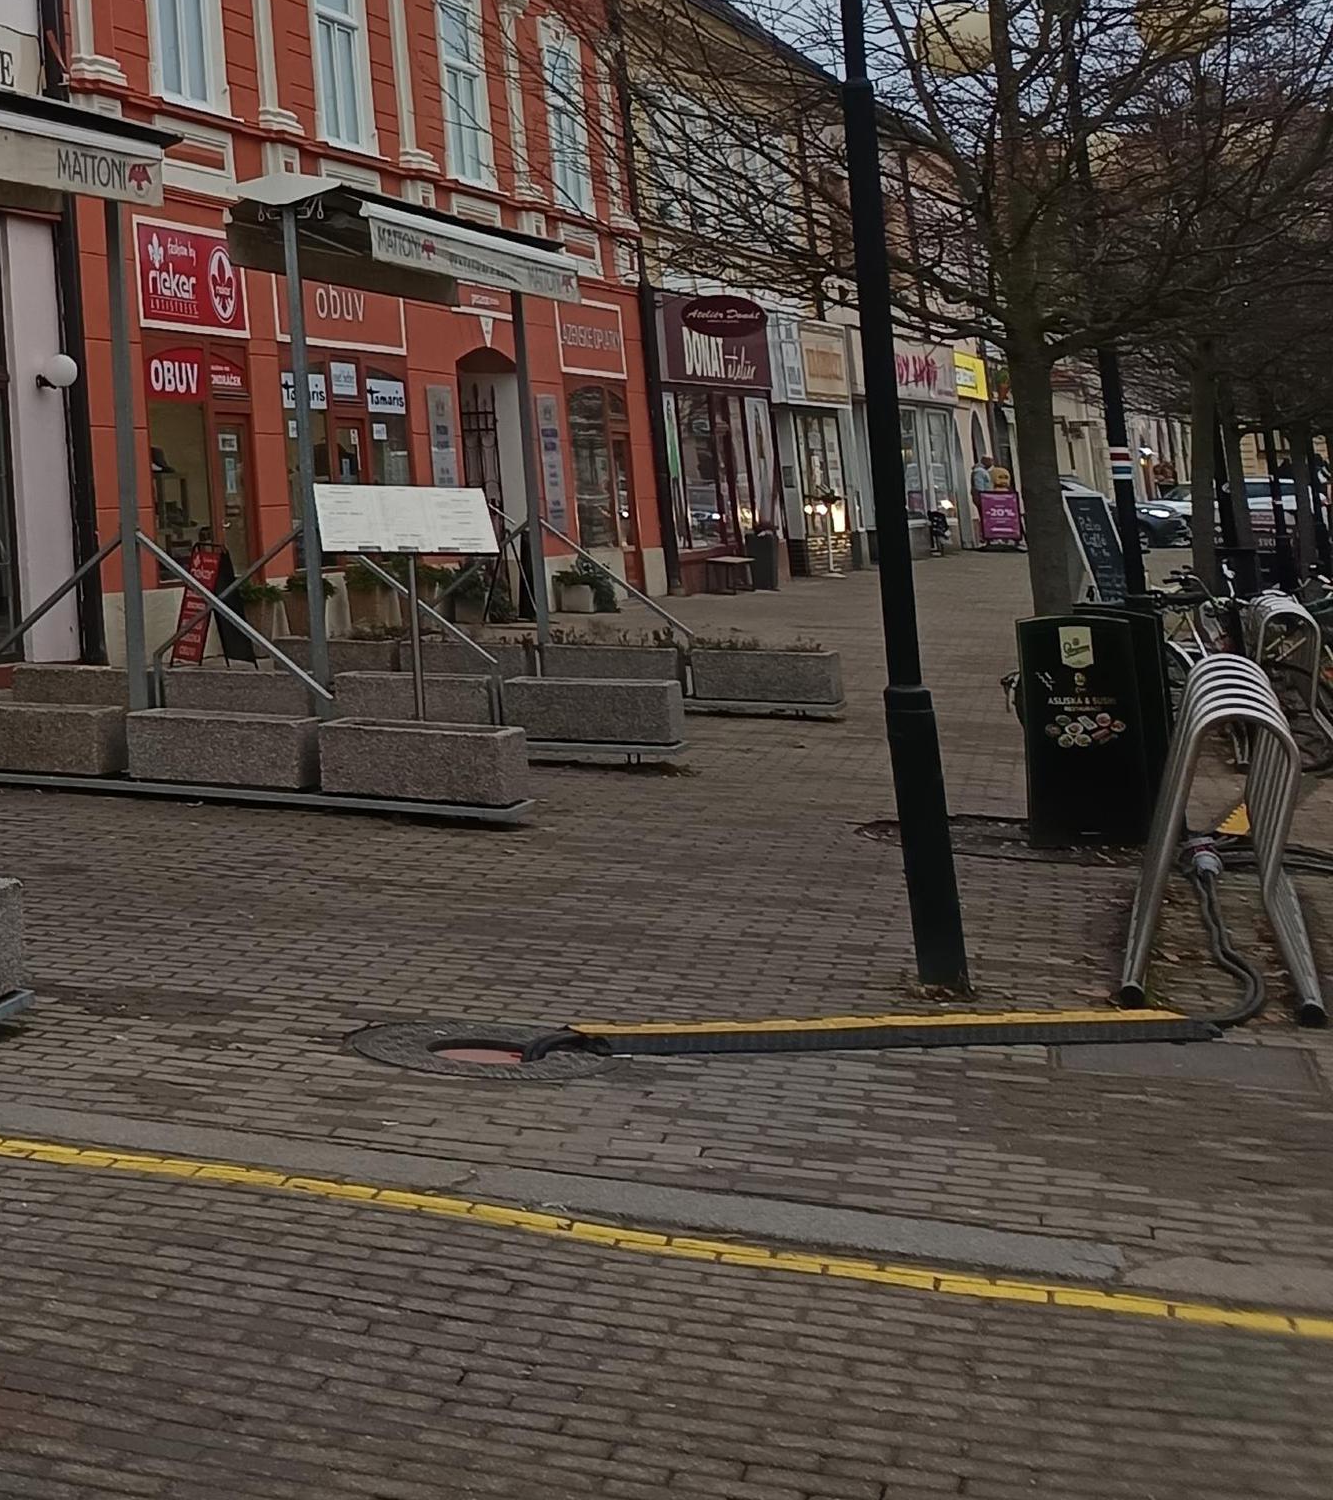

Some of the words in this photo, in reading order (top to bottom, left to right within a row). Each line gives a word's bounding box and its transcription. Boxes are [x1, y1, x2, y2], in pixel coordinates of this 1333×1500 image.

[57, 147, 128, 192] MATTONI
[148, 263, 197, 299] rieker
[316, 284, 365, 322] obuv
[150, 359, 199, 395] OBUV
